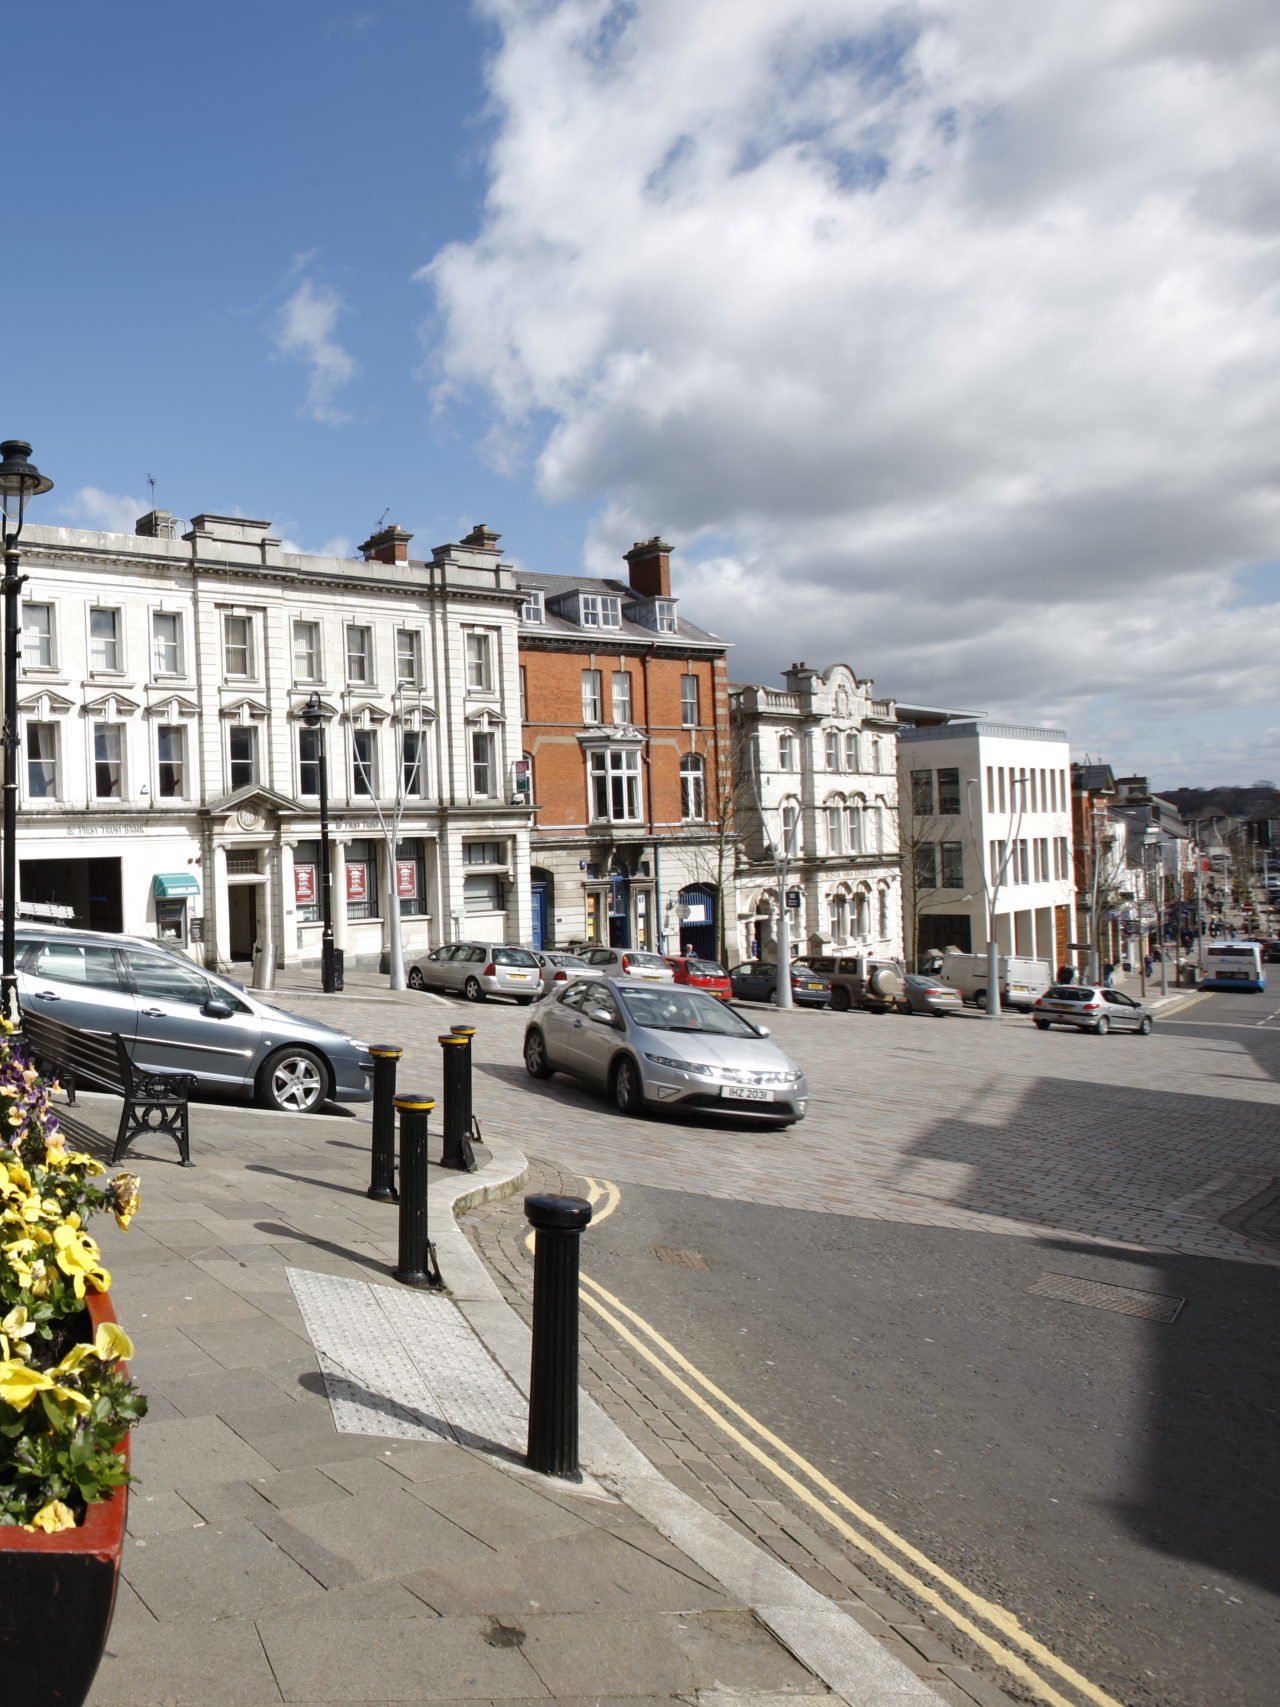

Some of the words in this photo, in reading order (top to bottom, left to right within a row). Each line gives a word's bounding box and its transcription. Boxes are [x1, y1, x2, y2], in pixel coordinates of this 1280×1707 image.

[78, 825, 99, 835] FIRST
[102, 825, 122, 834] TRUST
[125, 824, 145, 834] BANK
